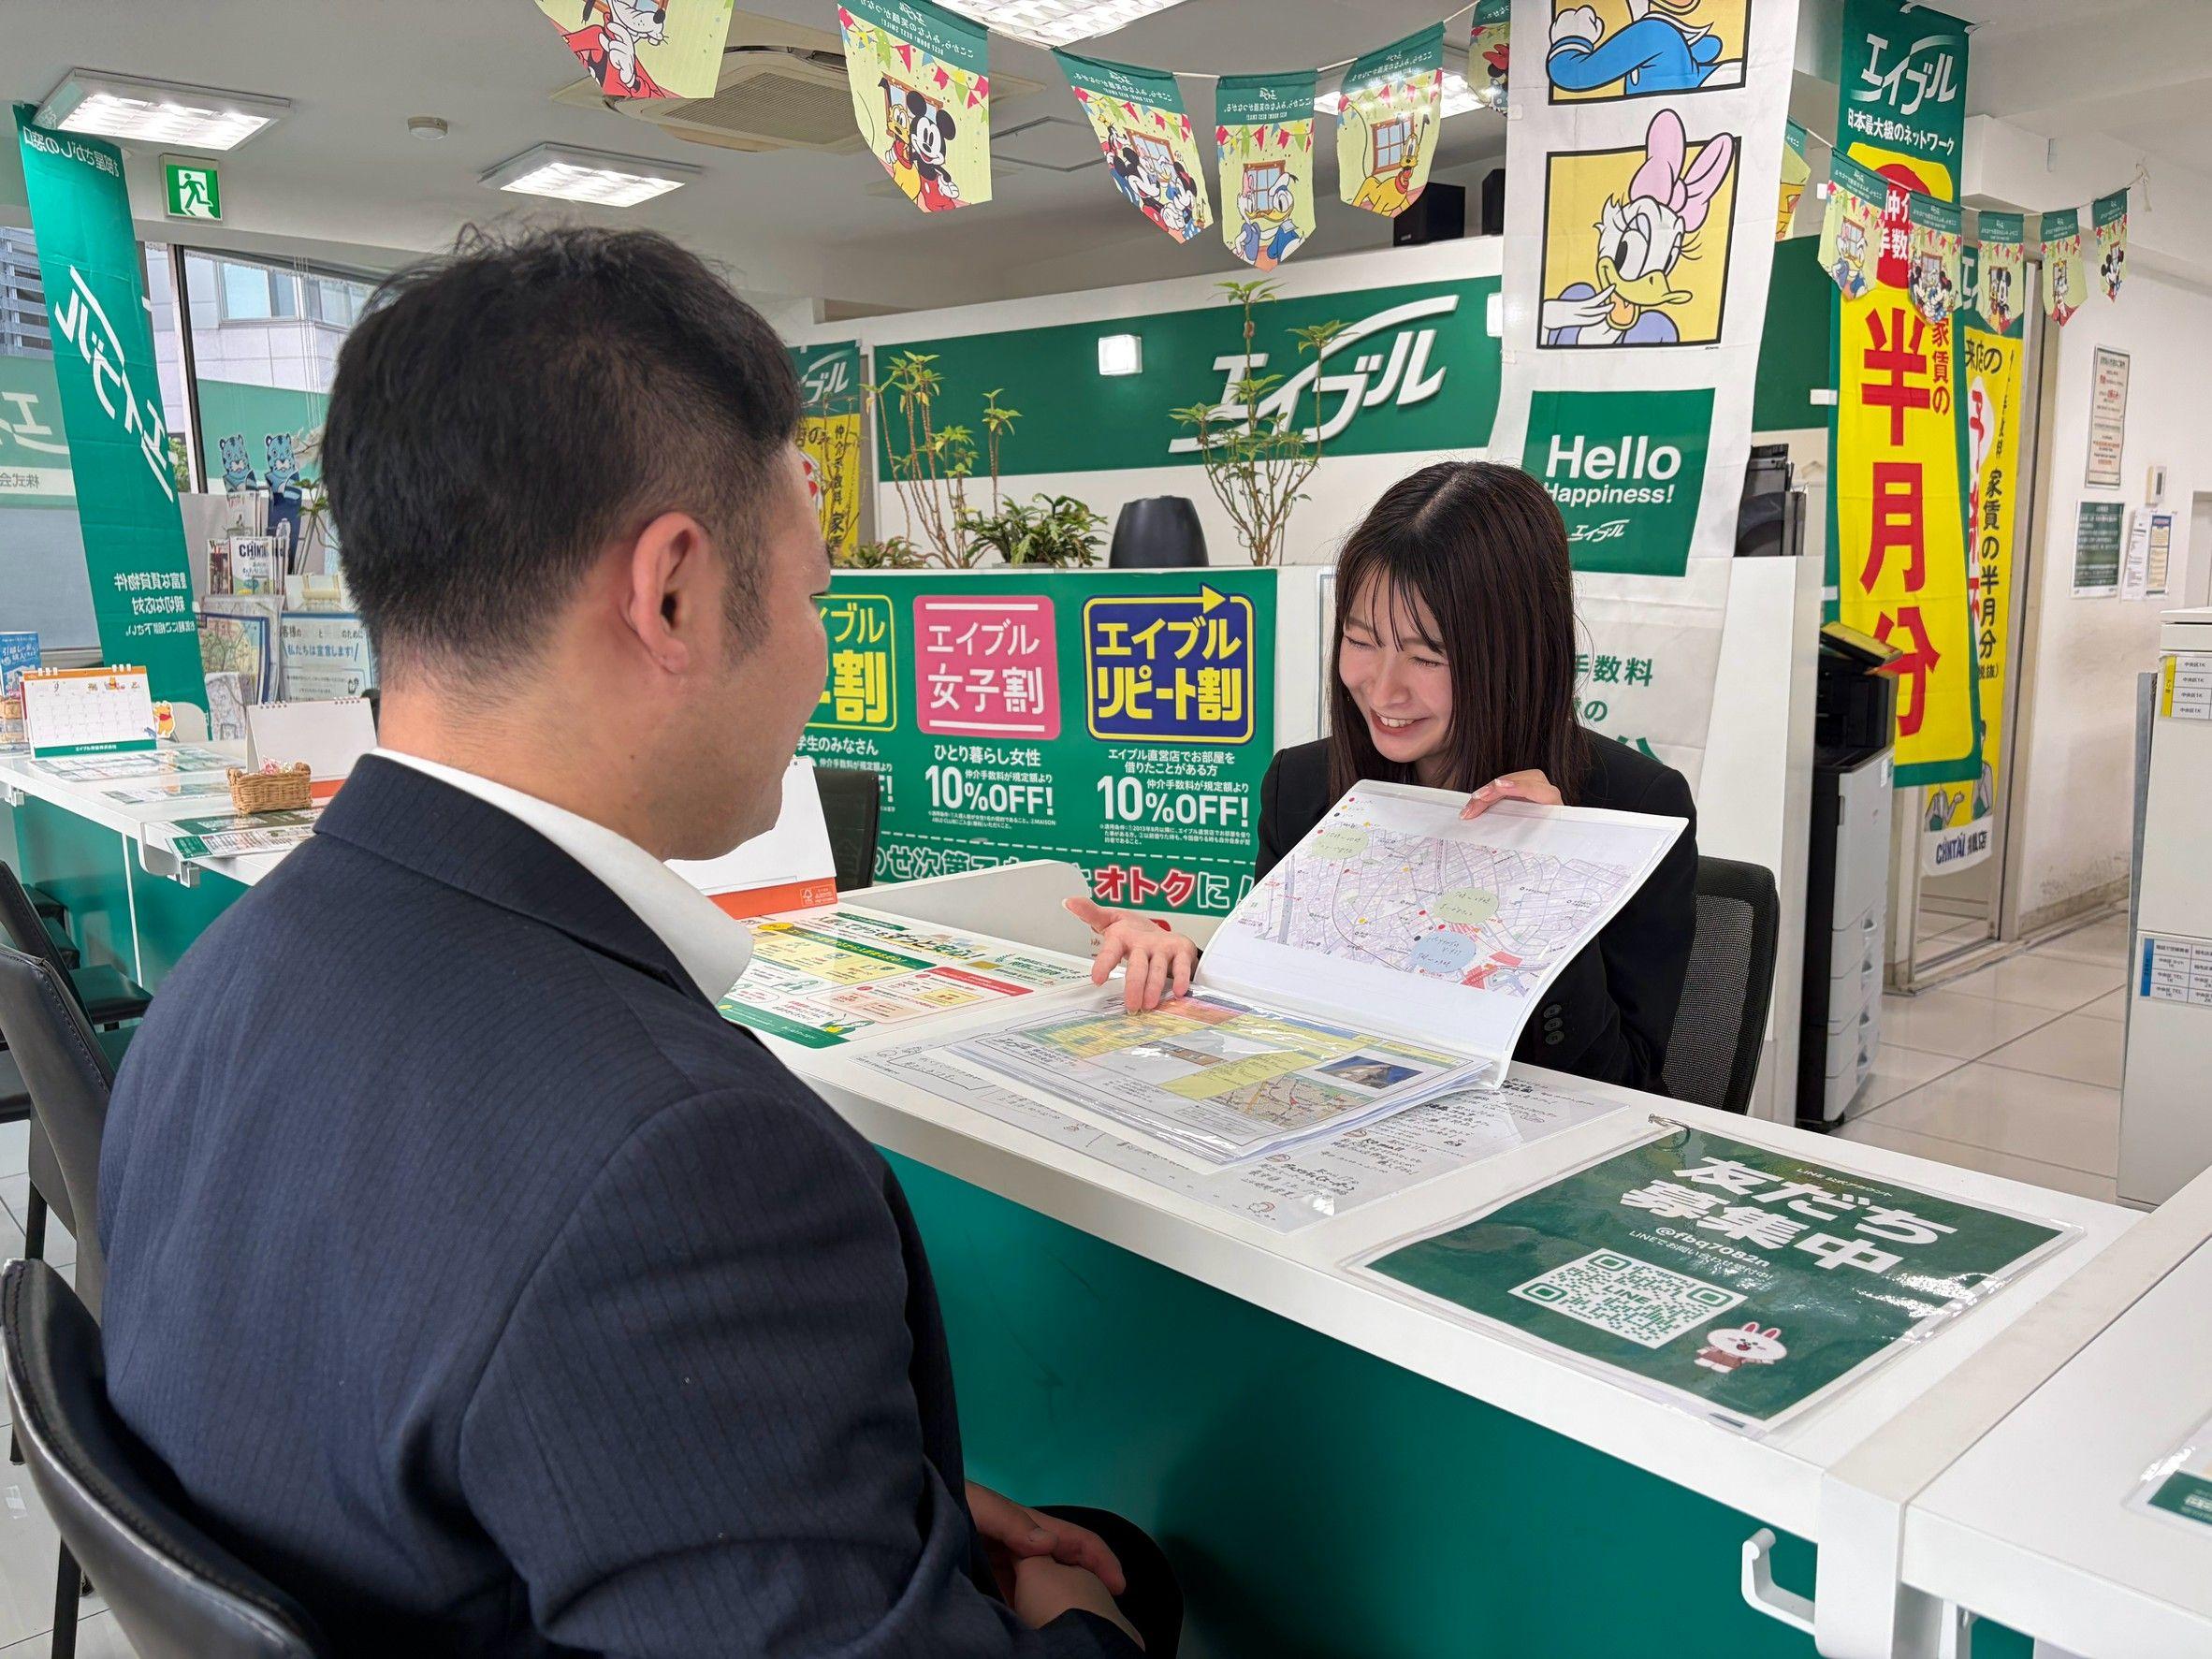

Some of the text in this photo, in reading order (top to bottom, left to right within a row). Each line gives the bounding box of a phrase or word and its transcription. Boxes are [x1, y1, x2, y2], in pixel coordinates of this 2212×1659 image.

[1848, 33, 1959, 115] エイブル
[1847, 108, 1956, 156] 日本最大級のネットワーク
[1168, 294, 1460, 454] エイブル
[1931, 317, 1950, 415] 家賃の
[1546, 434, 1681, 480] Hello
[1544, 482, 1676, 508] Happiness!
[1566, 518, 1630, 543] エイブル
[1859, 307, 1941, 737] 半月分
[1979, 468, 2002, 661] 家賃の半月分
[927, 618, 1041, 656] エイブル
[1096, 615, 1243, 660] エイブル
[927, 663, 1045, 715] 女子割
[1098, 664, 1243, 721] リピート割
[934, 744, 1041, 767] ひとり暮らし女性
[965, 769, 1054, 784] 仲介手数料が規定額より
[1108, 748, 1235, 764] エイブル直営店でお部屋を
[1125, 762, 1218, 778] 借りたことがある方
[1146, 779, 1249, 793] 仲介手数料が規定額より
[1671, 1156, 1957, 1247] 友だち
[1620, 1179, 1906, 1274] 募集中
